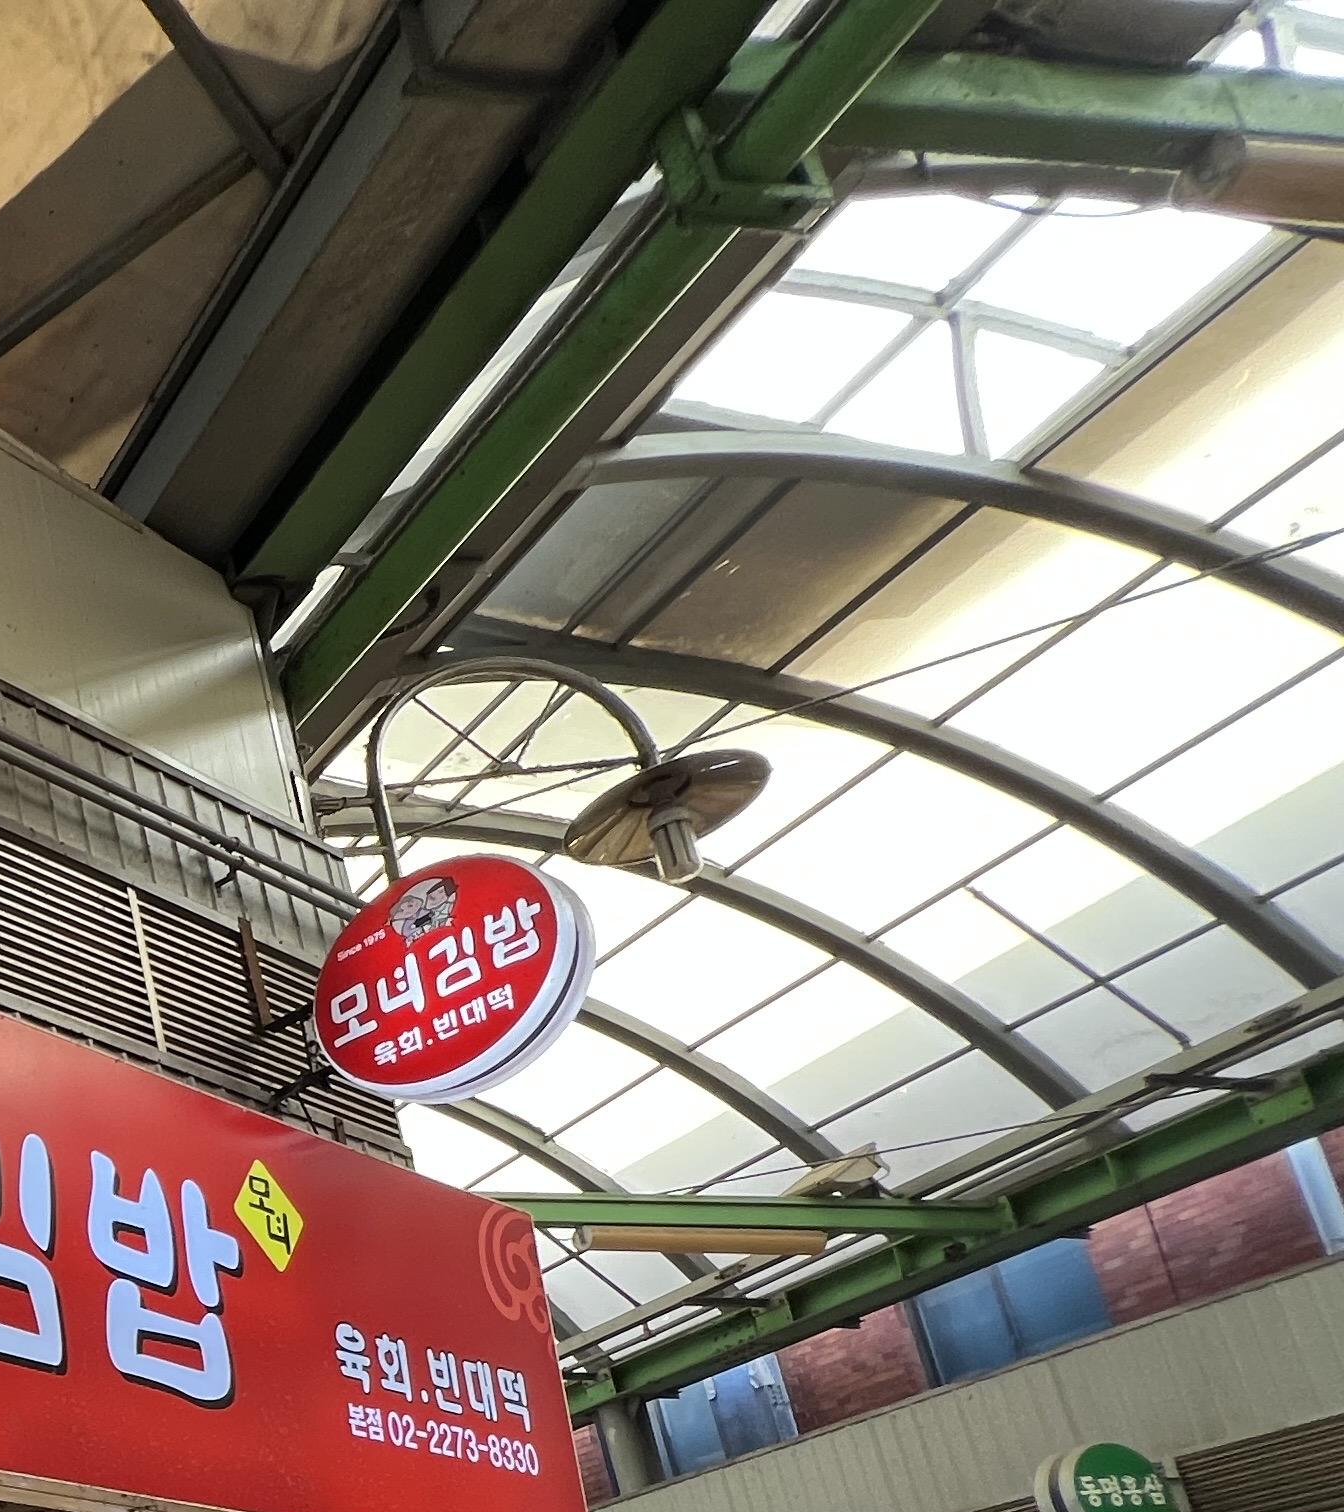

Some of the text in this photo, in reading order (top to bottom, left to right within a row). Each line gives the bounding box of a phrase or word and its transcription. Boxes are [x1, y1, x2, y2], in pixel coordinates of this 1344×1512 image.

[331, 897, 541, 1048] 모녀김밥
[249, 1175, 291, 1256] 모녀
[348, 1402, 540, 1477] 본점 02-2273-8330
[1079, 1474, 1166, 1508] 동명홍삼
